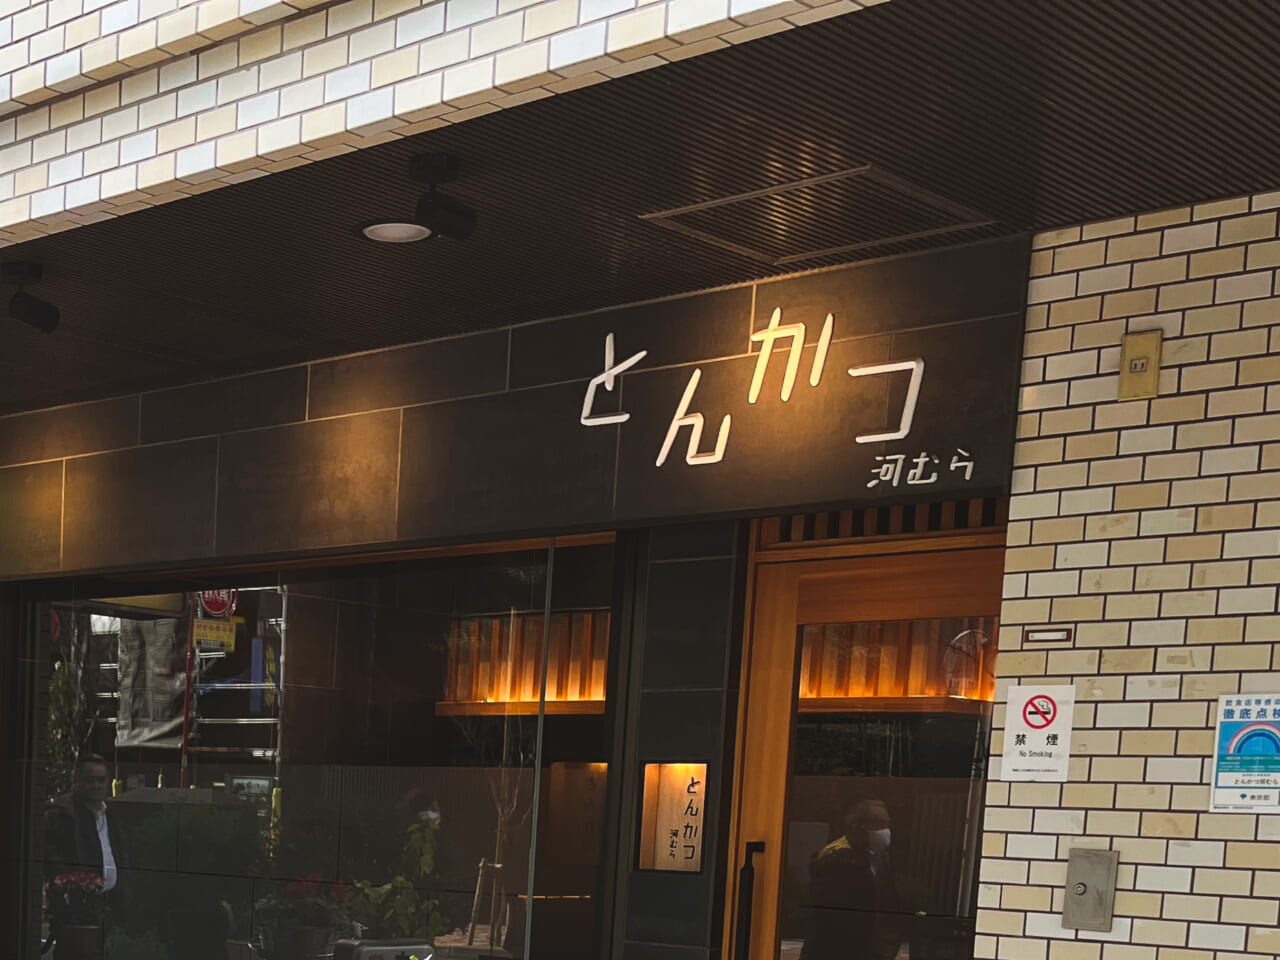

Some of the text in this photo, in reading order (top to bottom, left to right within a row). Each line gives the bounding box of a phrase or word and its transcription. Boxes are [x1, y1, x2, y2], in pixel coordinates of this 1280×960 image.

[581, 307, 924, 467] とんかつ
[867, 448, 974, 488] 河むら
[1014, 733, 1058, 746] 禁煙
[683, 776, 701, 860] とんかつ
